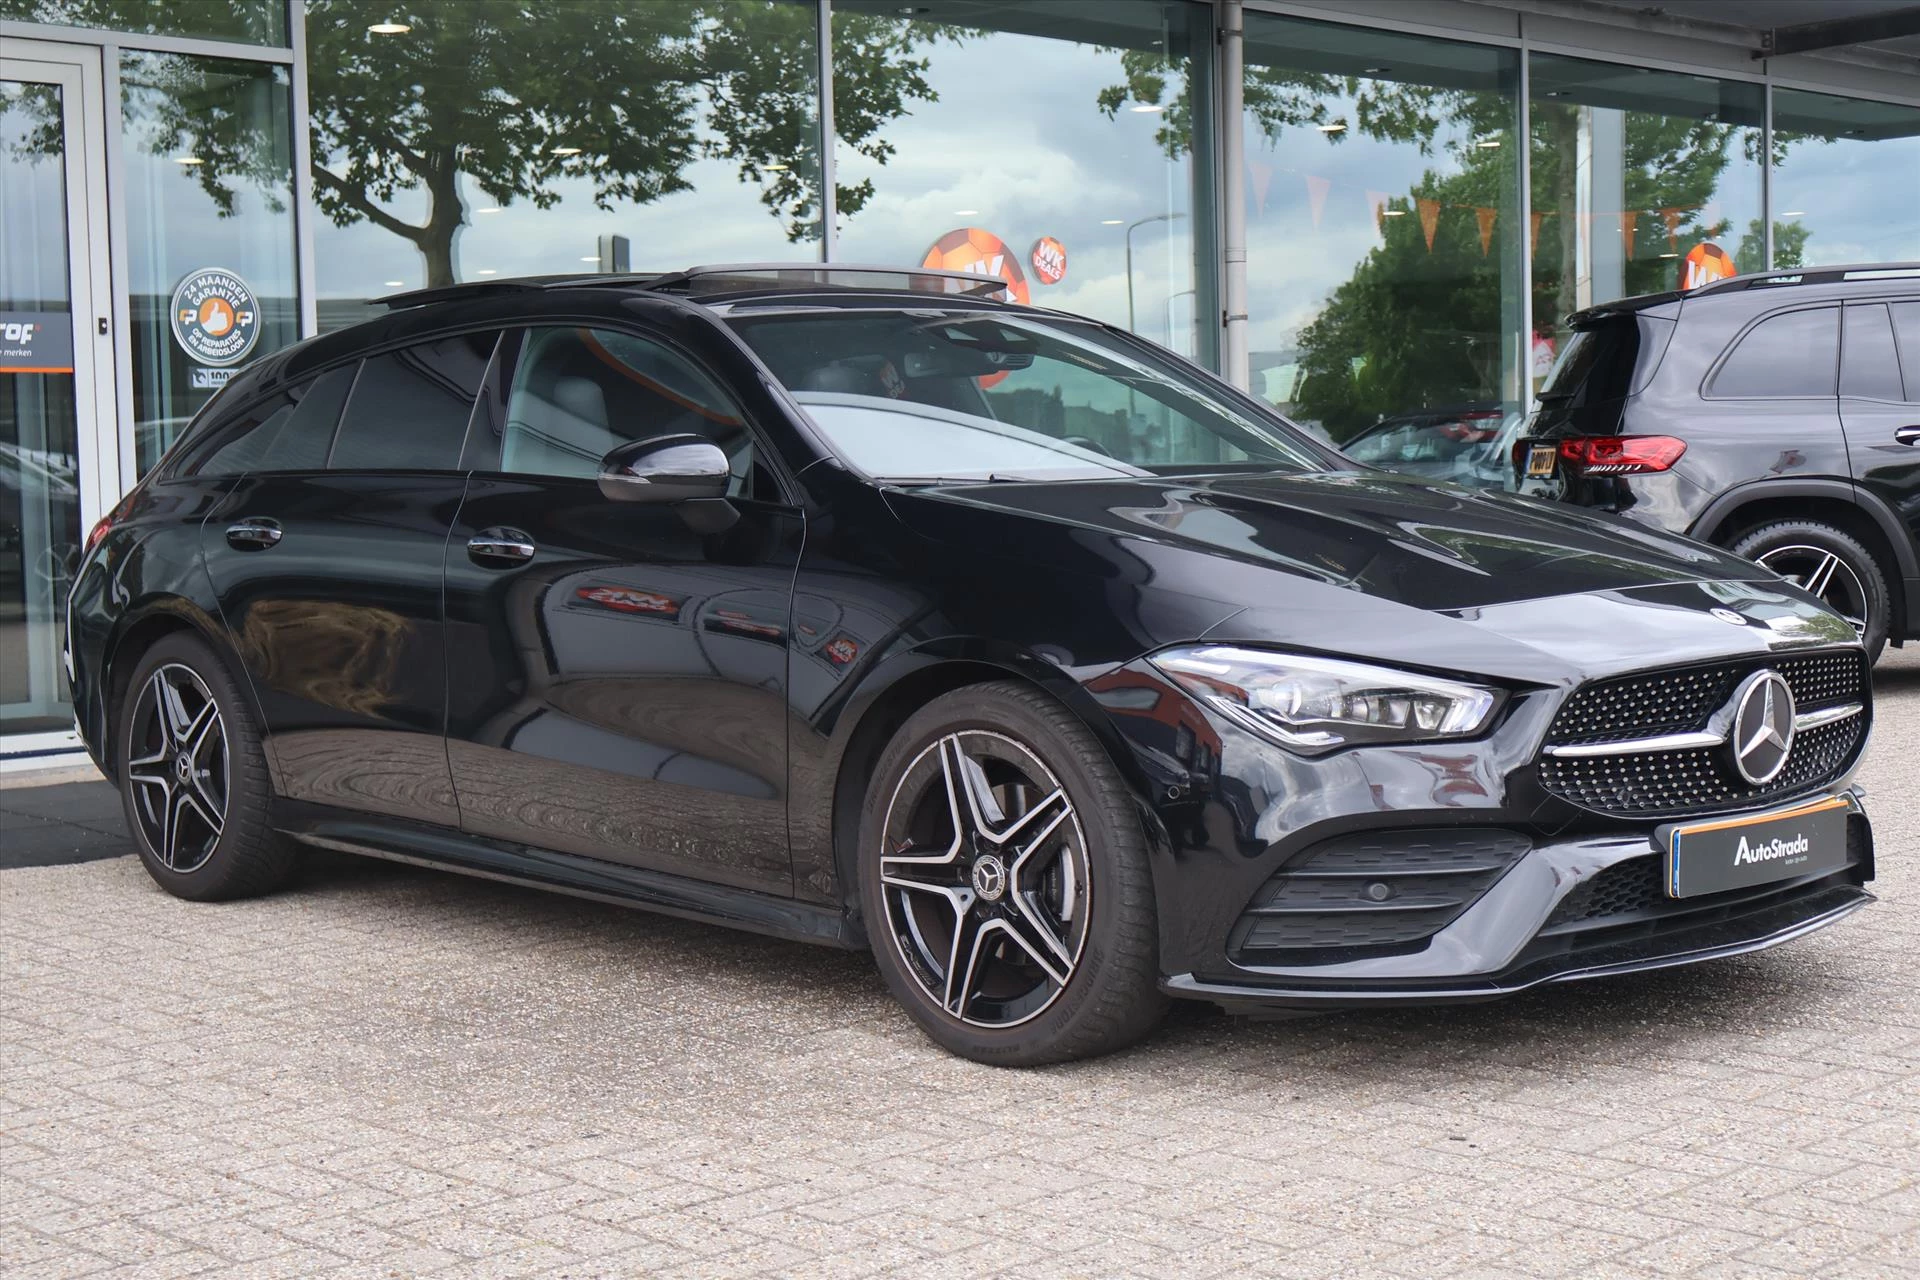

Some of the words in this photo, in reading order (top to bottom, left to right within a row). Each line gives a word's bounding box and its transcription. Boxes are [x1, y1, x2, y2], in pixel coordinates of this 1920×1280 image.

[1039, 241, 1064, 270] WK
[1034, 256, 1060, 280] DEALS
[184, 284, 197, 300] 24
[197, 275, 248, 303] MAANDEN
[192, 286, 240, 309] GARANTIE
[188, 335, 199, 347] EN
[198, 336, 245, 356] ARBEIDSLOON
[192, 328, 203, 339] OP
[202, 329, 241, 349] REPARATIES
[4, 348, 32, 357] merken
[1734, 833, 1808, 866] AutoStrada
